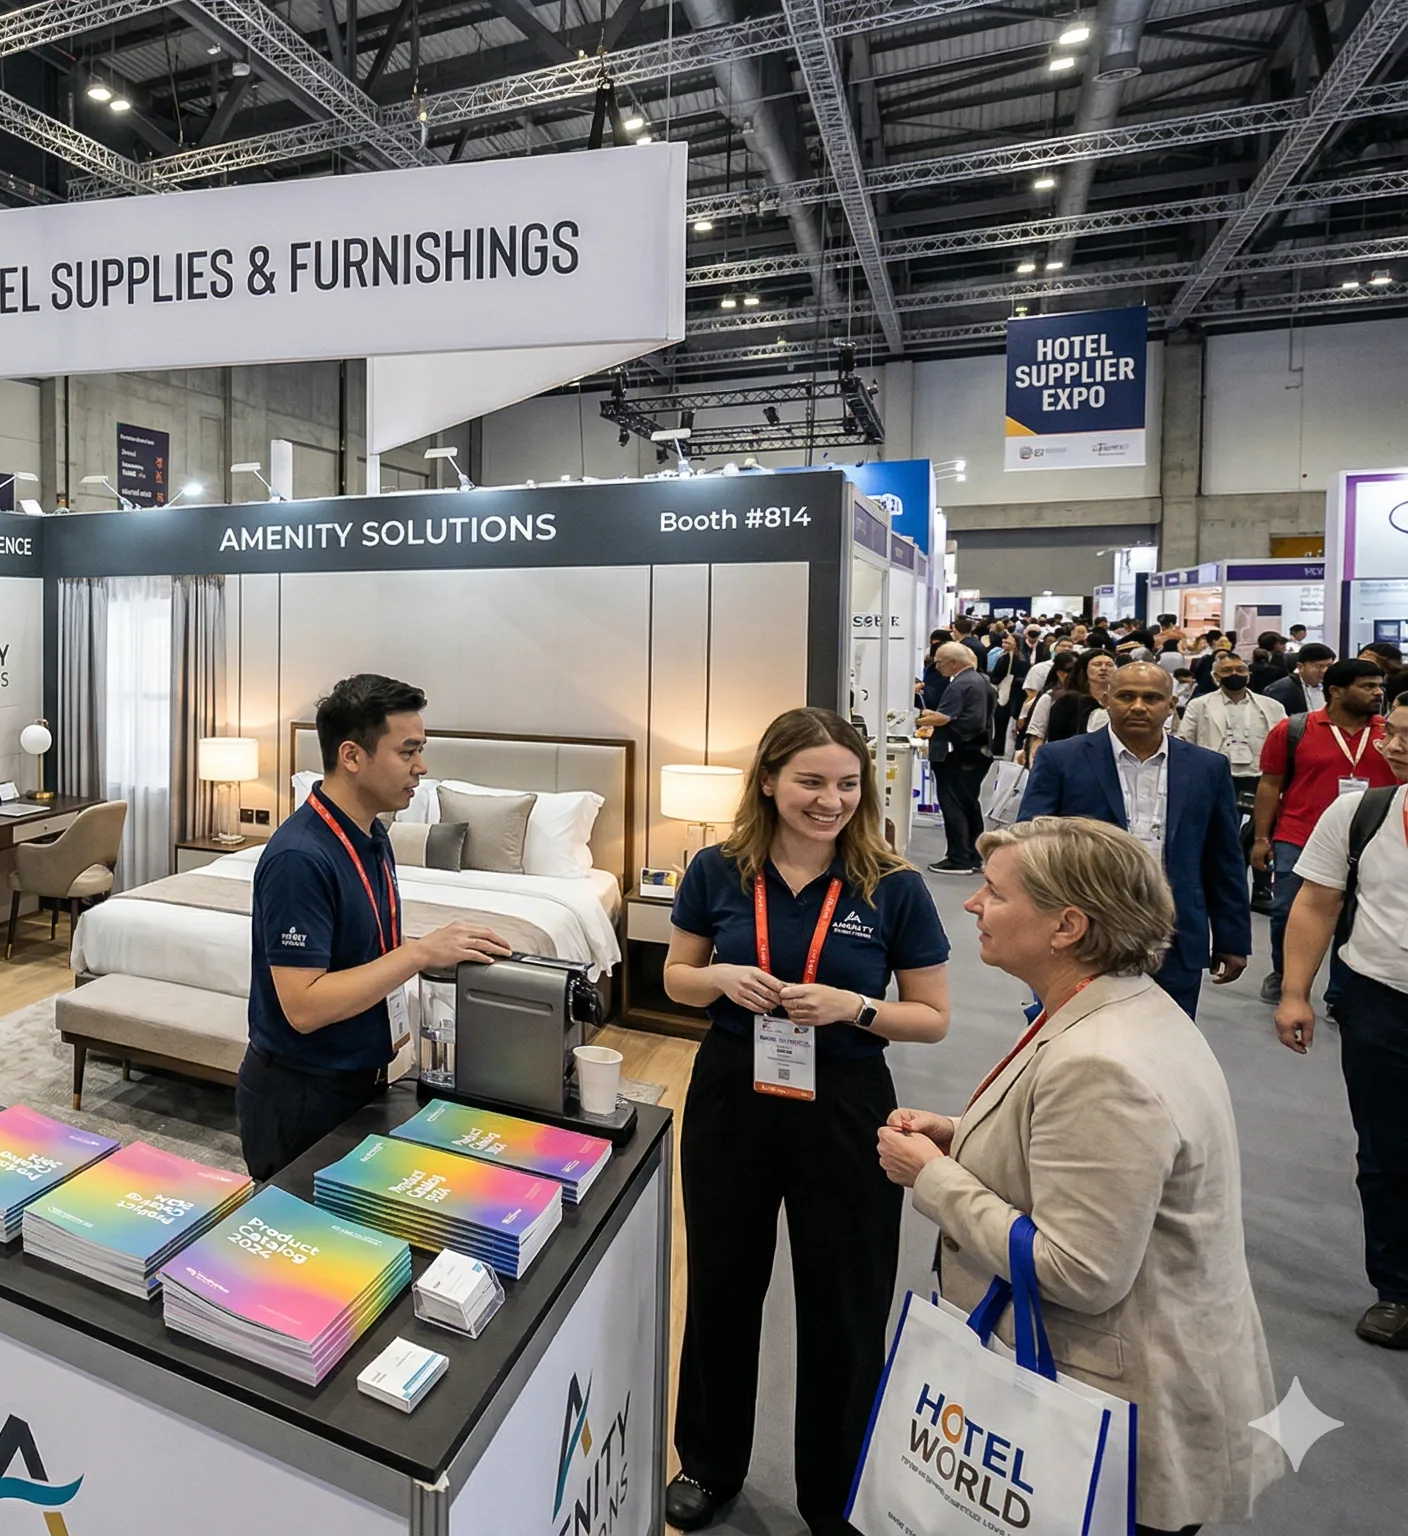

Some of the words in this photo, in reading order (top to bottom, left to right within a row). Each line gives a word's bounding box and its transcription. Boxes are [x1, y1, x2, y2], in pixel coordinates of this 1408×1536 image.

[50, 246, 234, 311] SUPPLIES
[247, 244, 276, 296] &
[291, 219, 580, 294] FURNISHINGS
[1037, 334, 1113, 362] HOTEL
[1015, 357, 1135, 388] SUPPLIER
[1042, 385, 1105, 411] EXPO
[219, 521, 353, 552] AMENITY
[361, 512, 556, 547] SOLUTIONS
[660, 509, 738, 534] Booth
[745, 505, 812, 530] #814
[238, 1225, 308, 1264] Catalog
[247, 1216, 321, 1257] Product
[915, 1383, 1034, 1495] HOTEL
[559, 1390, 631, 1536] NITY
[909, 1418, 1031, 1529] WORLD
